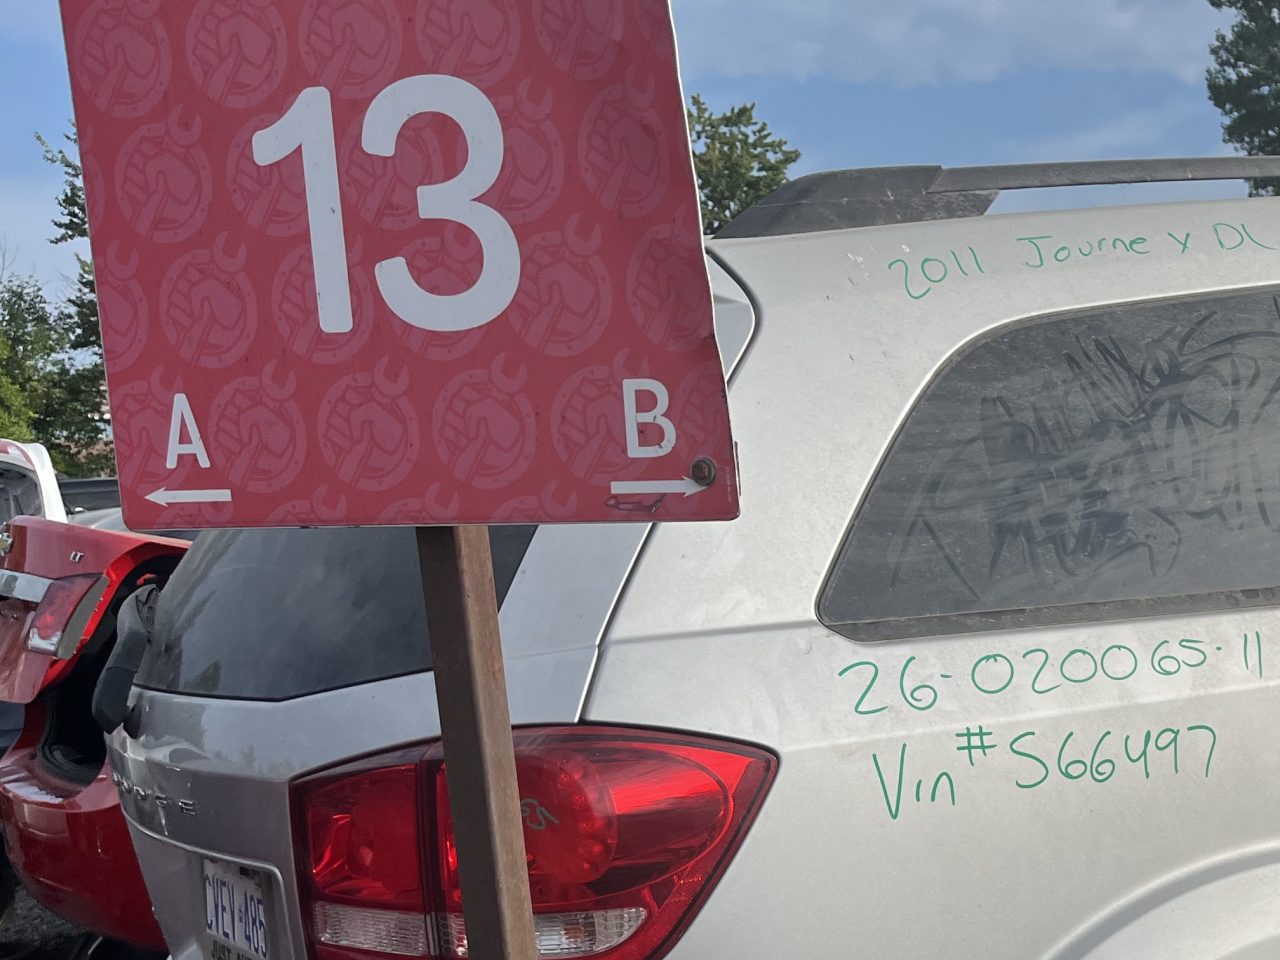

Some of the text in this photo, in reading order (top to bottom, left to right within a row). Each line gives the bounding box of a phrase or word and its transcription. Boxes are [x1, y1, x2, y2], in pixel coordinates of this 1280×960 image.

[252, 73, 521, 333] 13
[888, 246, 985, 299] 2011
[165, 393, 210, 469] A
[621, 378, 677, 459] B
[244, 891, 267, 958] 485
